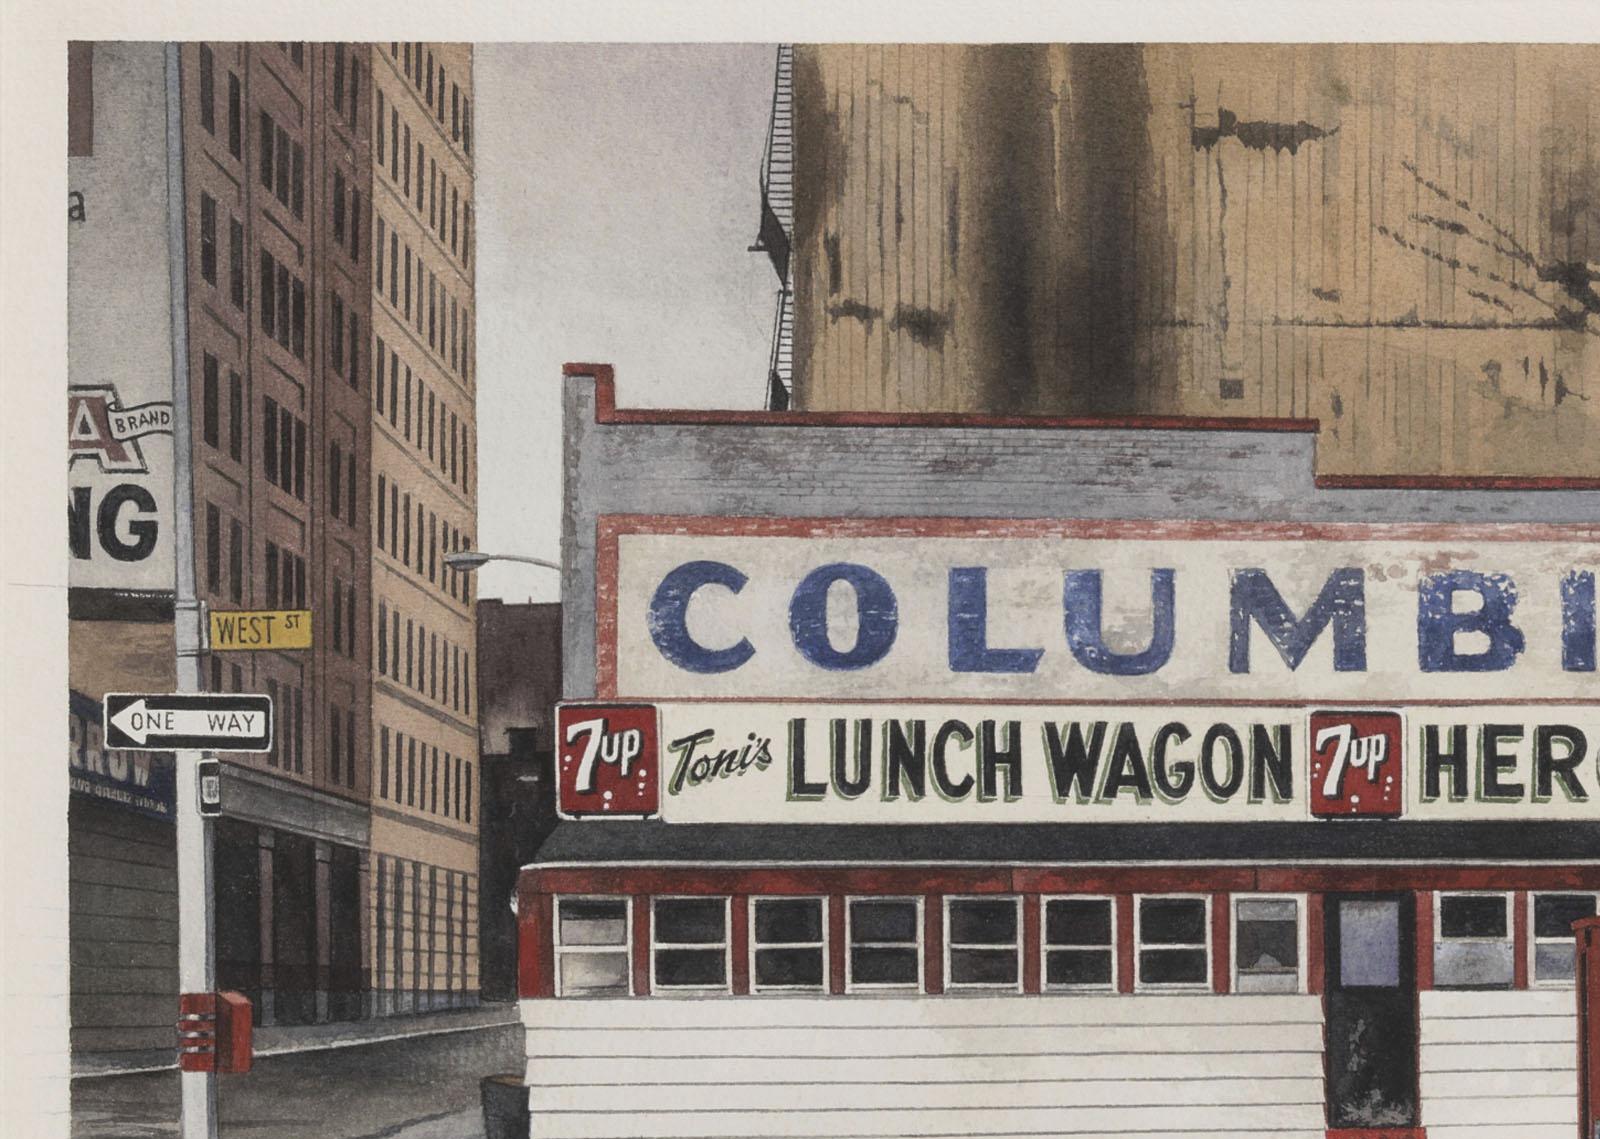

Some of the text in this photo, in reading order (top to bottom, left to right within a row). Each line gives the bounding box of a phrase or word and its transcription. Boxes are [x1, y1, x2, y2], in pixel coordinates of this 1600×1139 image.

[115, 410, 171, 435] BRAND
[216, 613, 300, 645] WEST ST
[131, 711, 256, 732] ONE WAY
[668, 717, 1293, 806] Toni's LUNCH WAGON
